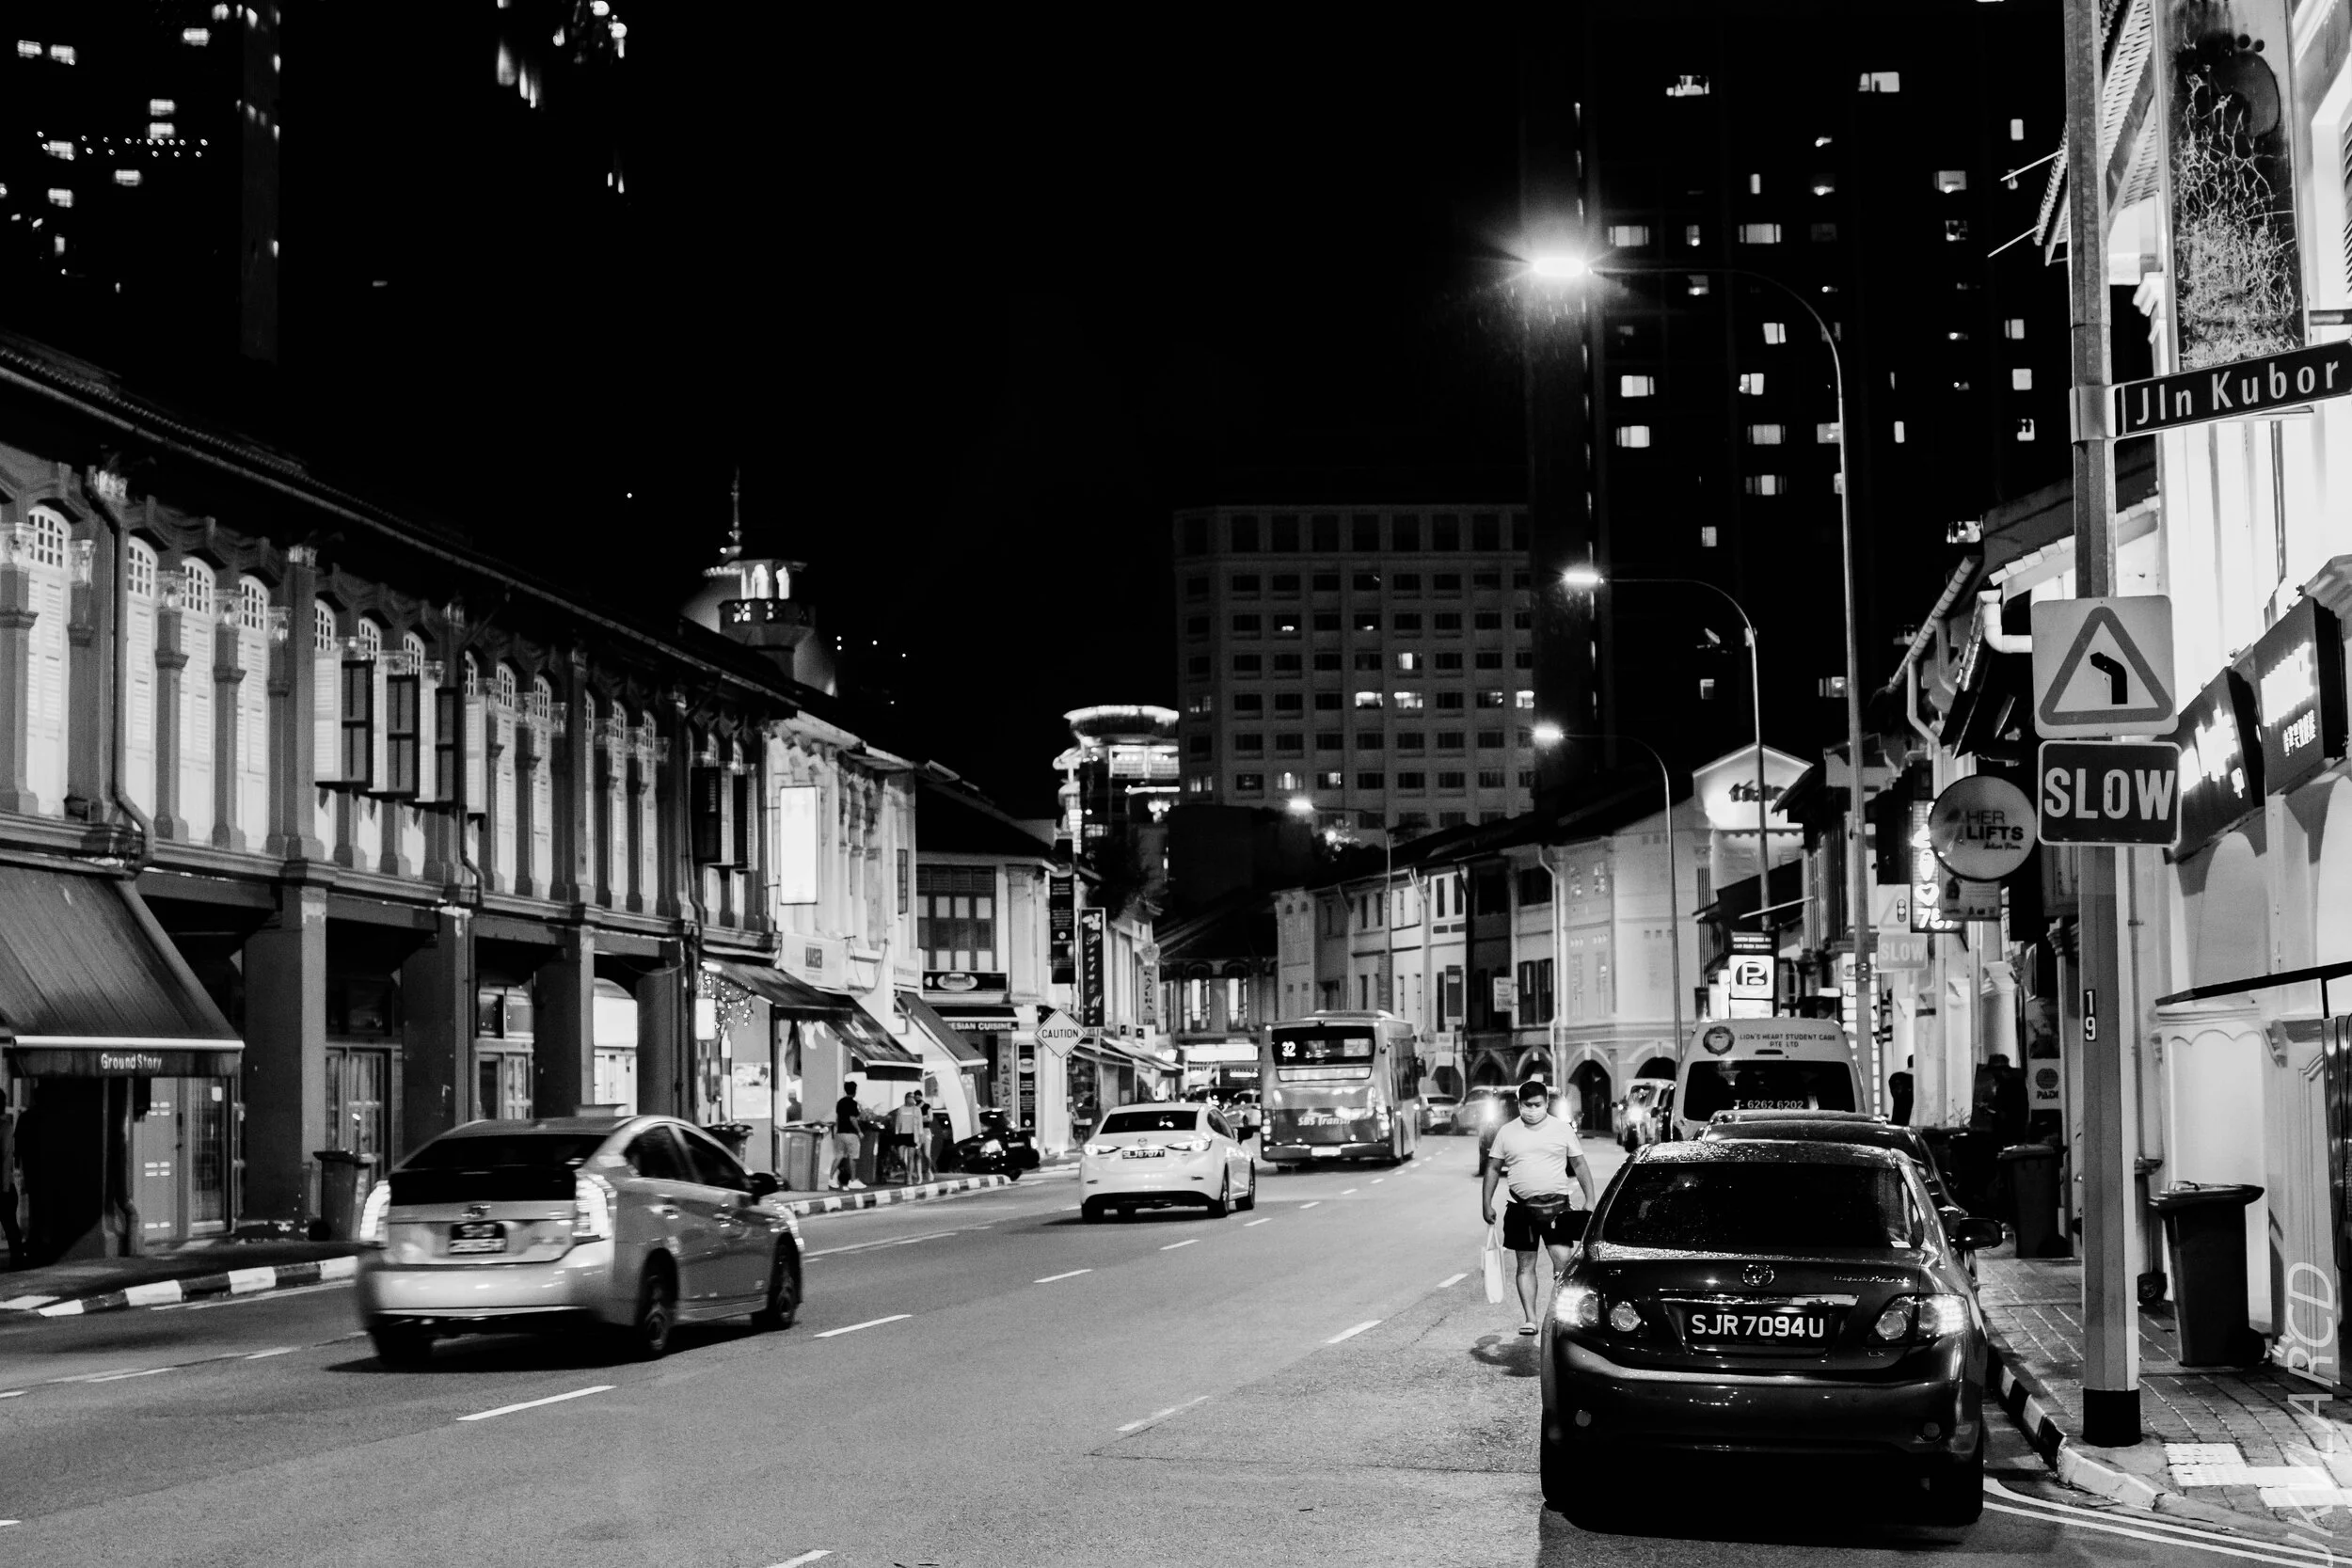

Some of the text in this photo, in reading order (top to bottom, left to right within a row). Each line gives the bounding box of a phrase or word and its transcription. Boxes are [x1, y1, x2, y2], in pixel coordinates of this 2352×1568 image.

[2136, 360, 2340, 426] Jln Kubor
[2044, 767, 2176, 821] SLOW
[1966, 810, 2005, 825] HER
[1966, 826, 2024, 841] LIFTS
[1881, 942, 1926, 961] SLOW
[977, 1022, 1012, 1031] CUISINE
[1041, 1029, 1079, 1038] CAUTION
[1281, 1040, 1296, 1057] 32
[2036, 1090, 2059, 1100] PADI
[1747, 1099, 1774, 1110] 6262
[1776, 1099, 1804, 1110] 6202
[1297, 1117, 1315, 1126] SBS
[1691, 1313, 1825, 1338] SJR 7094U
